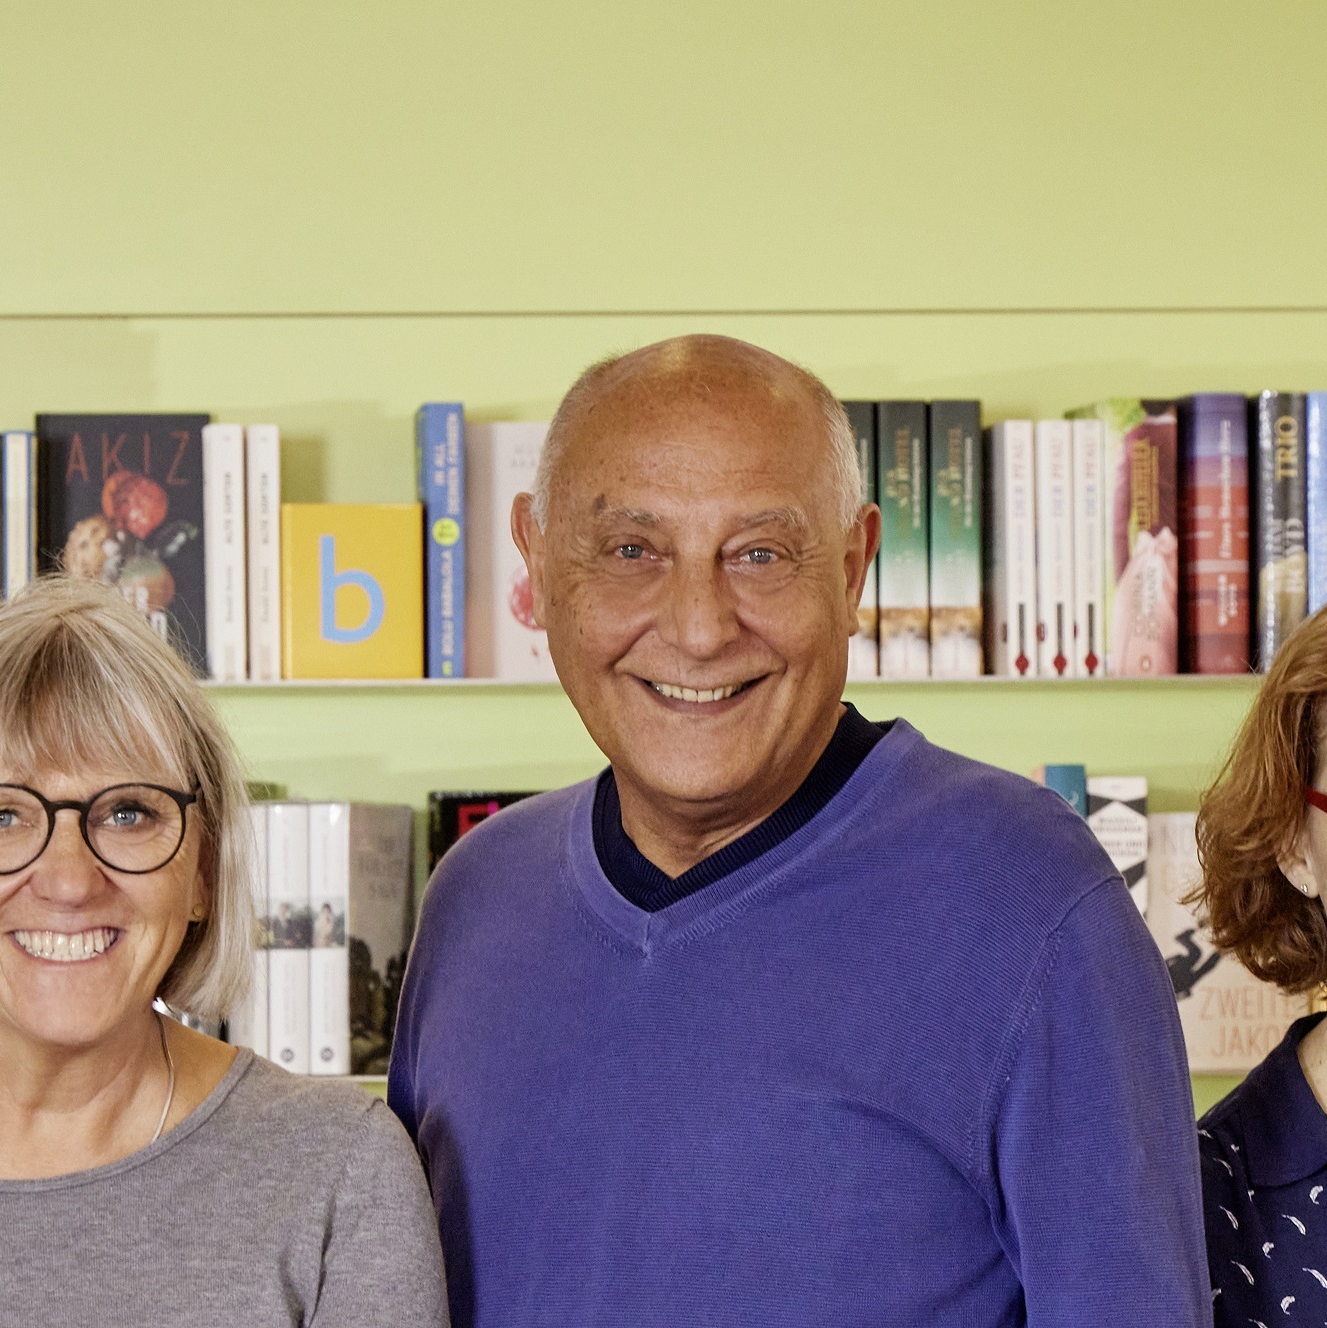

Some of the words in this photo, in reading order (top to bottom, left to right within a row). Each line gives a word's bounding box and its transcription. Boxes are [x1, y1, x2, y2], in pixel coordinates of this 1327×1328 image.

[64, 430, 192, 487] AKIZ
[1274, 415, 1300, 482] TRIO
[319, 533, 386, 644] b
